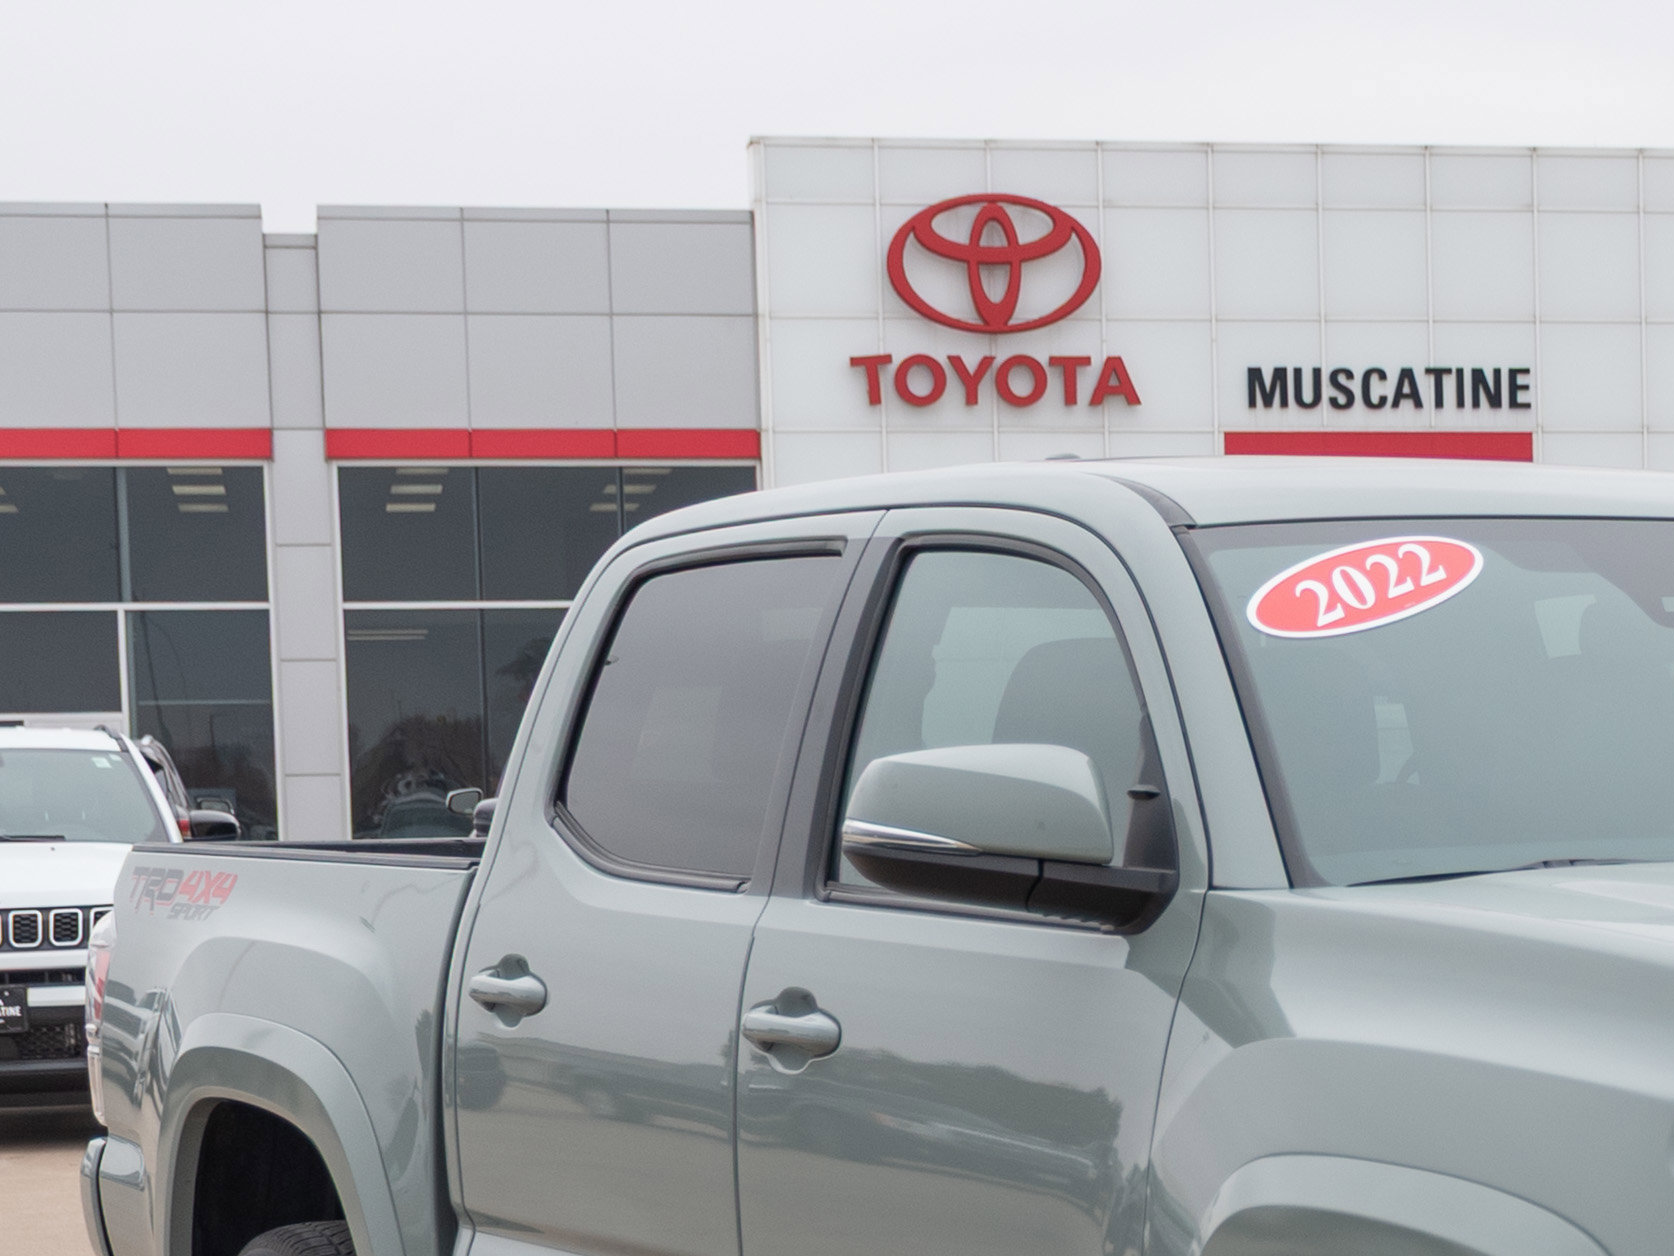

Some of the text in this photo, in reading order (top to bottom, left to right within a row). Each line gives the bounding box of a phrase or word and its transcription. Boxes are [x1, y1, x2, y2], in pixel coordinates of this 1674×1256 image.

[851, 354, 1140, 406] TOYOTA
[1248, 368, 1531, 410] MUSCATINE
[1295, 544, 1448, 627] 2022
[129, 866, 184, 916] TRD
[166, 903, 221, 920] SPORT
